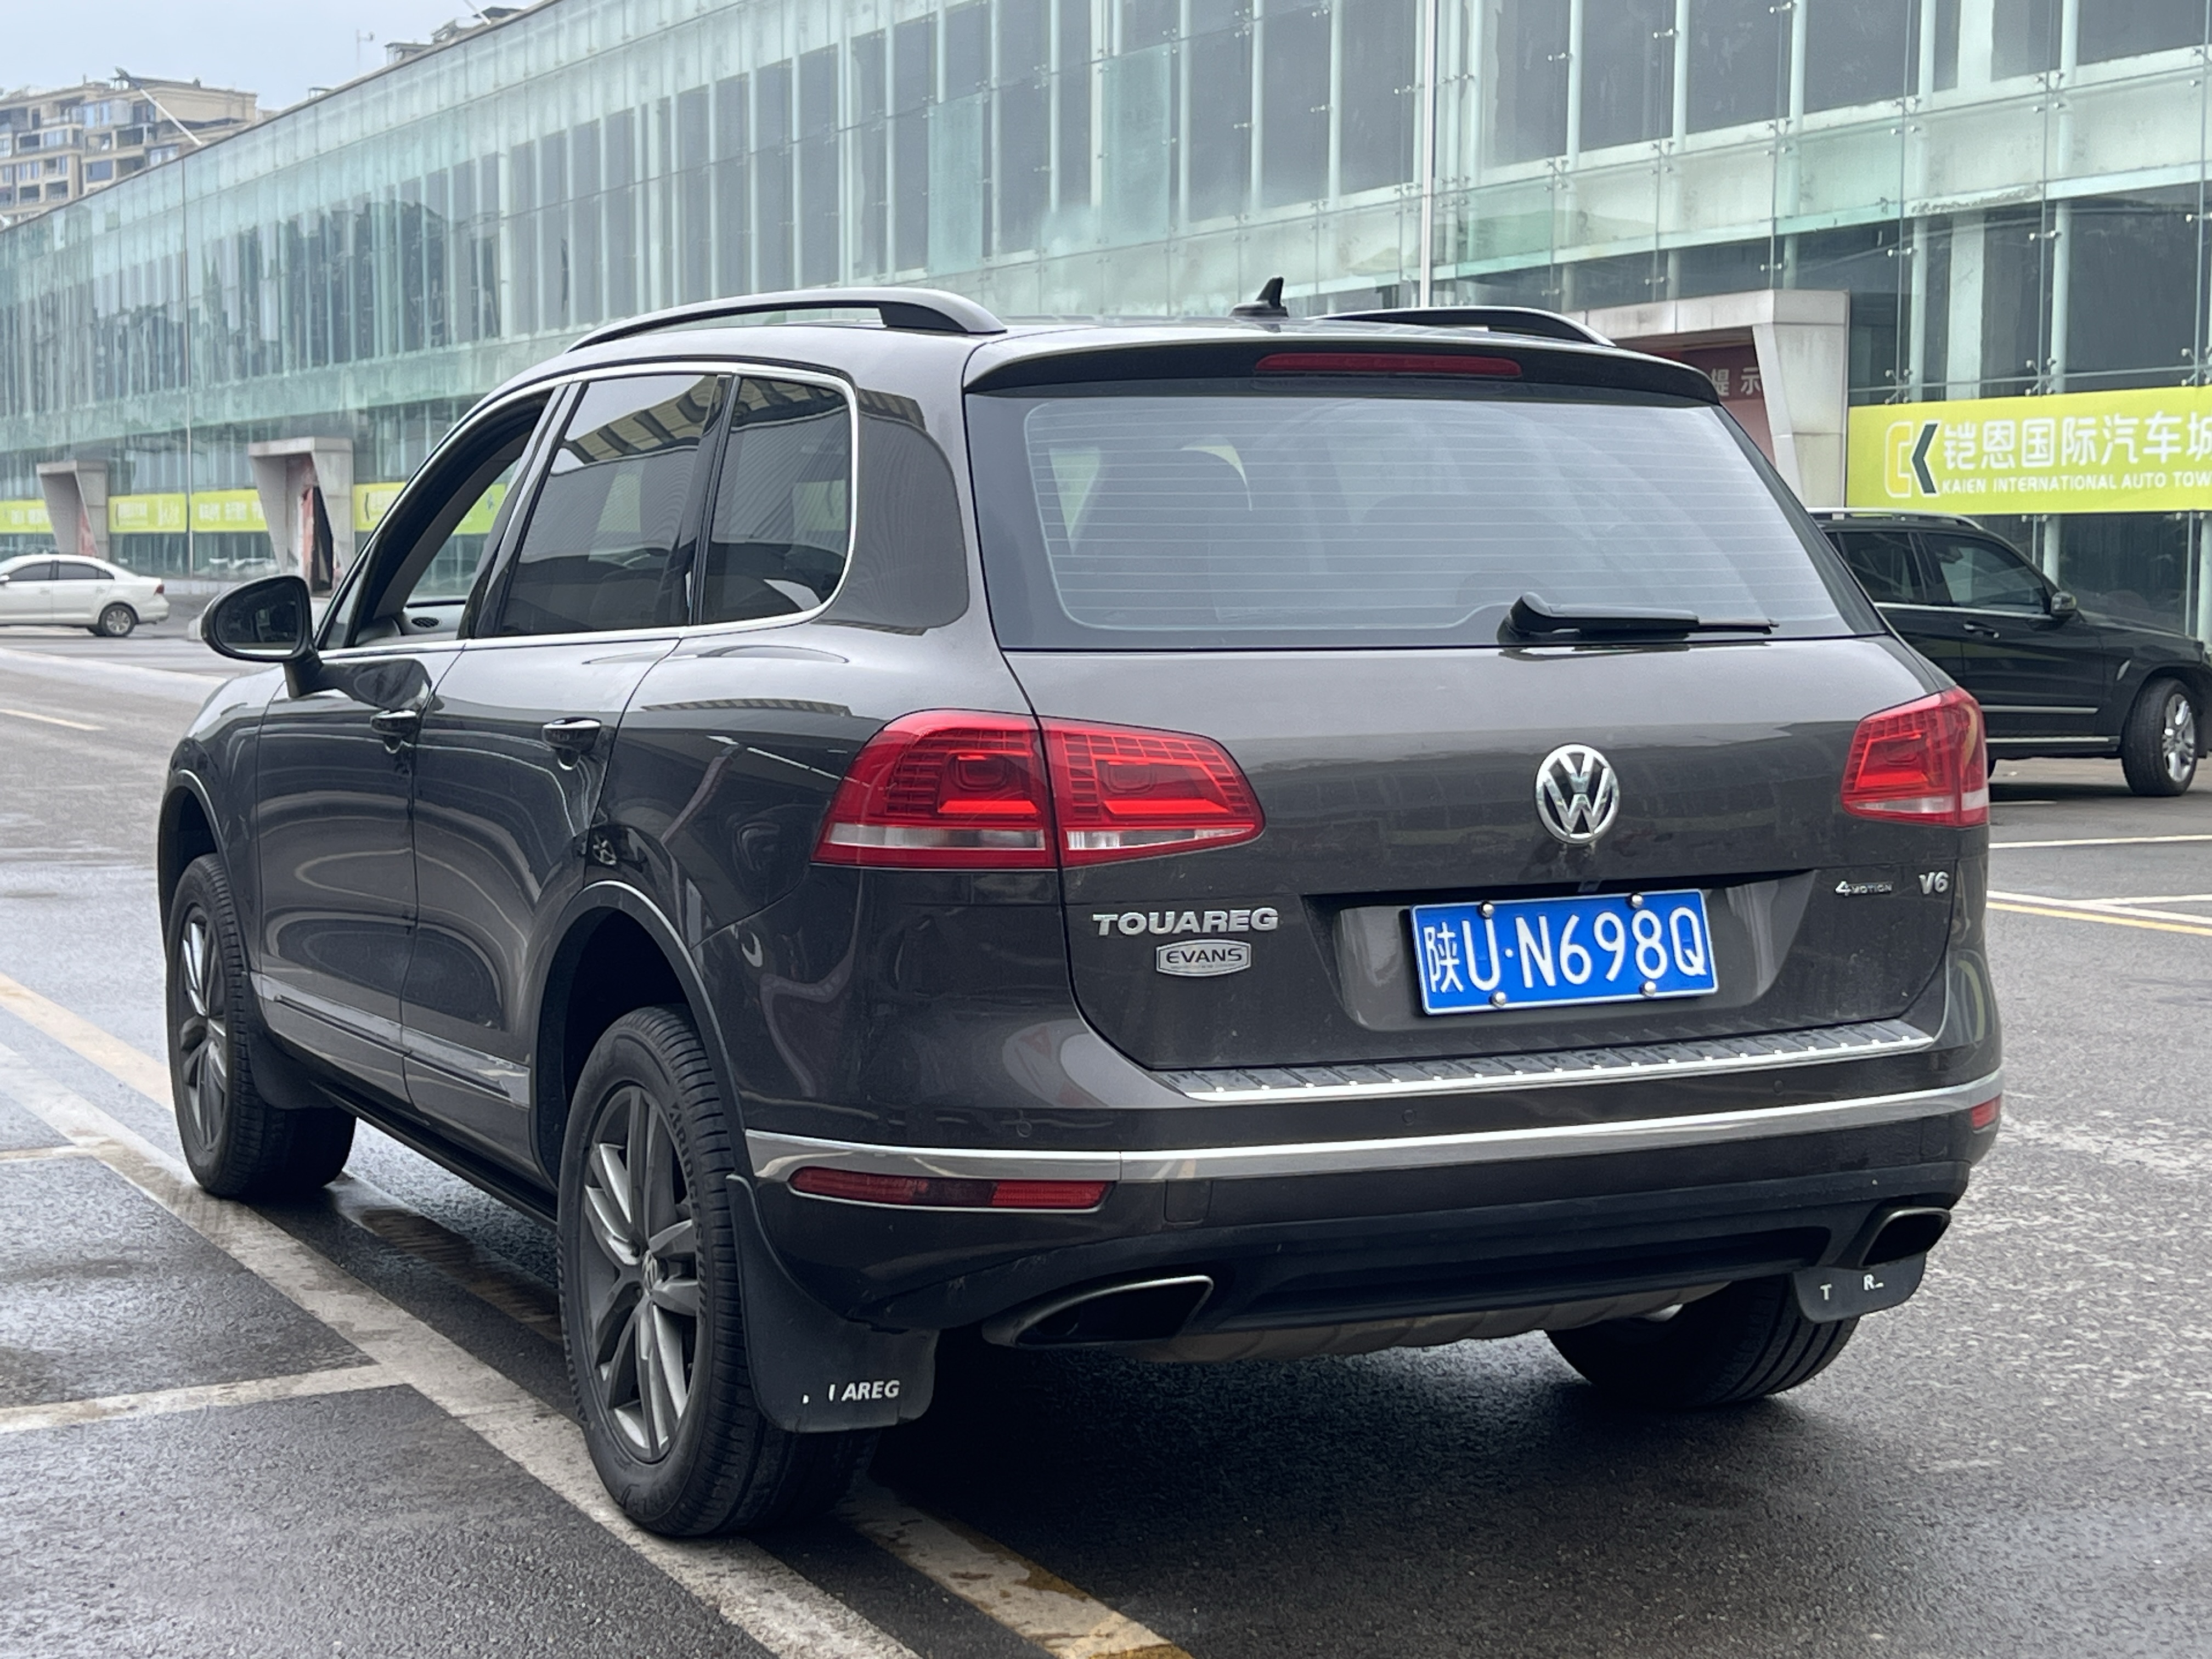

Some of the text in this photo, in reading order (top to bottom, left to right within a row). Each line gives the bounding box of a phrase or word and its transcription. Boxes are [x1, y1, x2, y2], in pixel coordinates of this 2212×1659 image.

[1942, 477, 1987, 494] KAIEN
[1993, 474, 2115, 493] INTERNATIONAL
[2121, 472, 2167, 489] AUTO
[1918, 871, 1949, 895] V6
[1092, 907, 1279, 936] TOUAREG
[1166, 948, 1243, 964] EVANS
